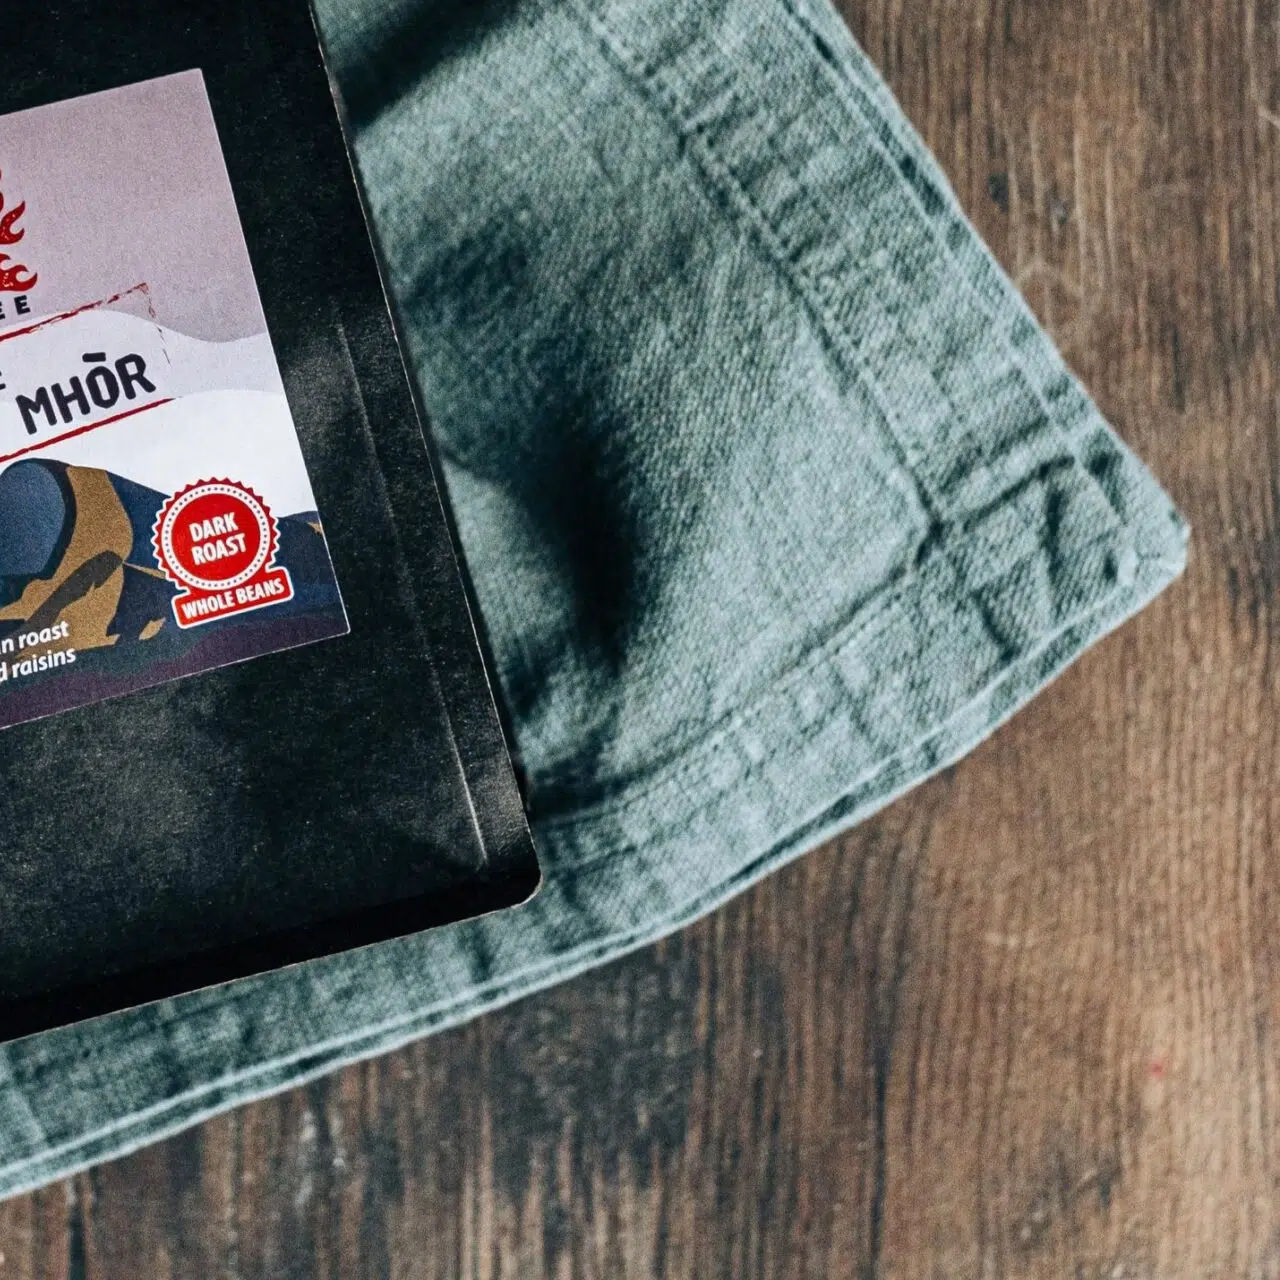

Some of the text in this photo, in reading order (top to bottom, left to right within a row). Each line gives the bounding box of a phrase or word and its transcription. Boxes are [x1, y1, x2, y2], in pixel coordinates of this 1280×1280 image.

[189, 512, 239, 542] DARK
[192, 533, 246, 565] ROAST
[181, 577, 285, 619] WHOLE BEANS
[18, 620, 70, 650] roast
[12, 647, 76, 679] raisins
